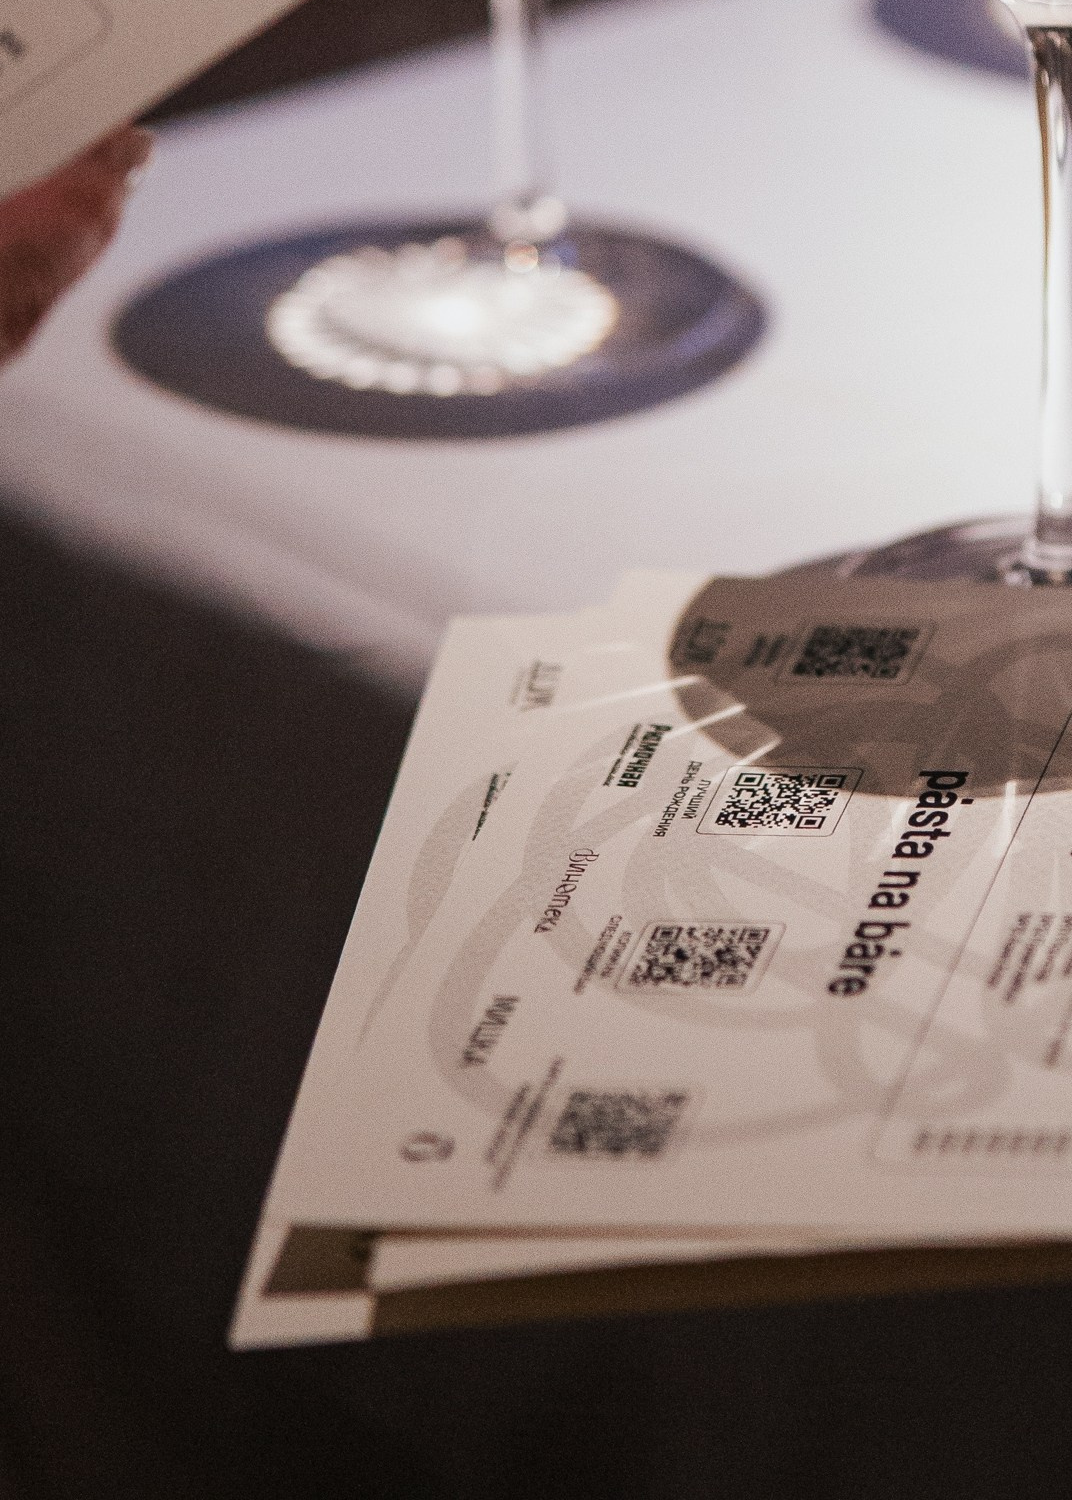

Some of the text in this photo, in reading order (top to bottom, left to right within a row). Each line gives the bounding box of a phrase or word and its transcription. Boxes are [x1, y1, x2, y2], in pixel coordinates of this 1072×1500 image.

[653, 761, 702, 837] ДЕНЬ РОЖДЕНИЯ
[682, 779, 711, 819] ЛУЧШИЙ
[533, 848, 597, 932] Винотека
[868, 871, 919, 908] na
